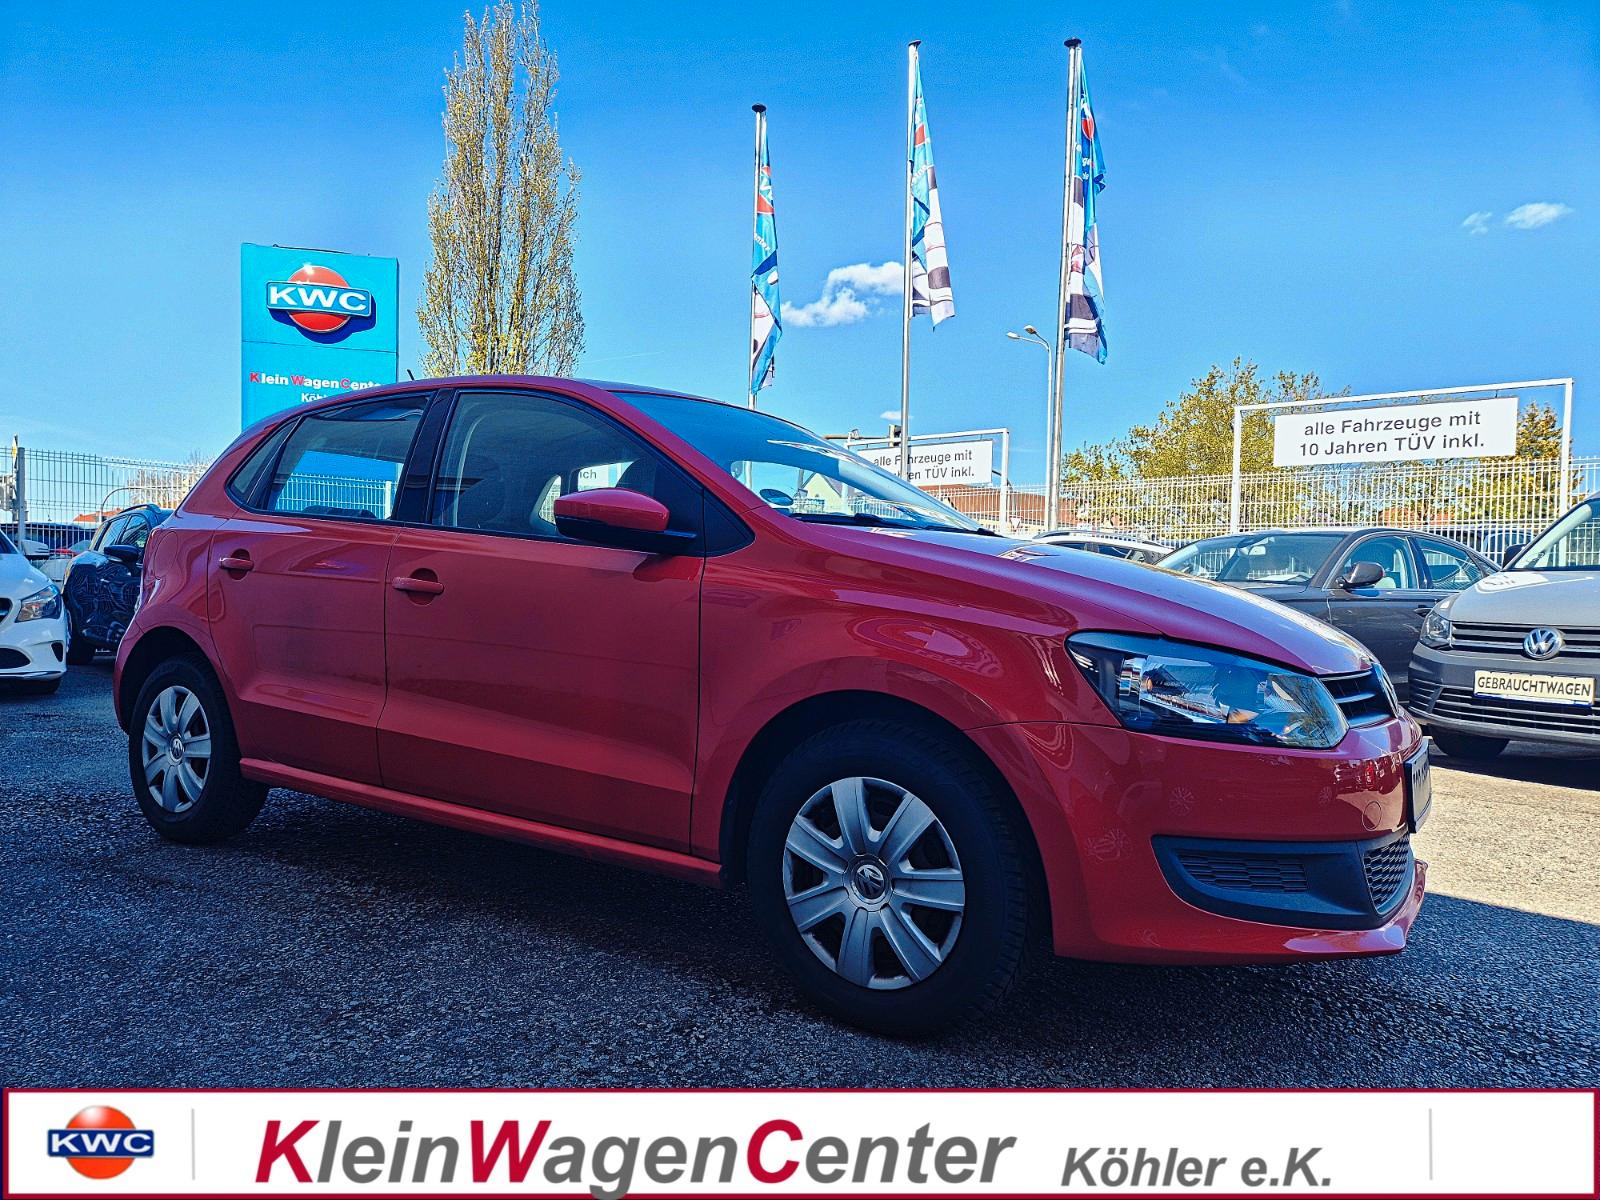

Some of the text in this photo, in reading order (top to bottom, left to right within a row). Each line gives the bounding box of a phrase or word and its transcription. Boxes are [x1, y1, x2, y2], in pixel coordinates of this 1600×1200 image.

[269, 286, 367, 311] KWC
[301, 392, 328, 402] Köh
[1304, 410, 1481, 436] alle Fahrzeuge mit
[1300, 432, 1485, 457] 10 Jahren TÜV inkl.
[874, 449, 973, 466] alle Fhrzeuge mit
[925, 465, 948, 479] TÜV
[951, 466, 975, 478] inkl.
[1477, 677, 1591, 696] GEBRAUCHTWAGEN
